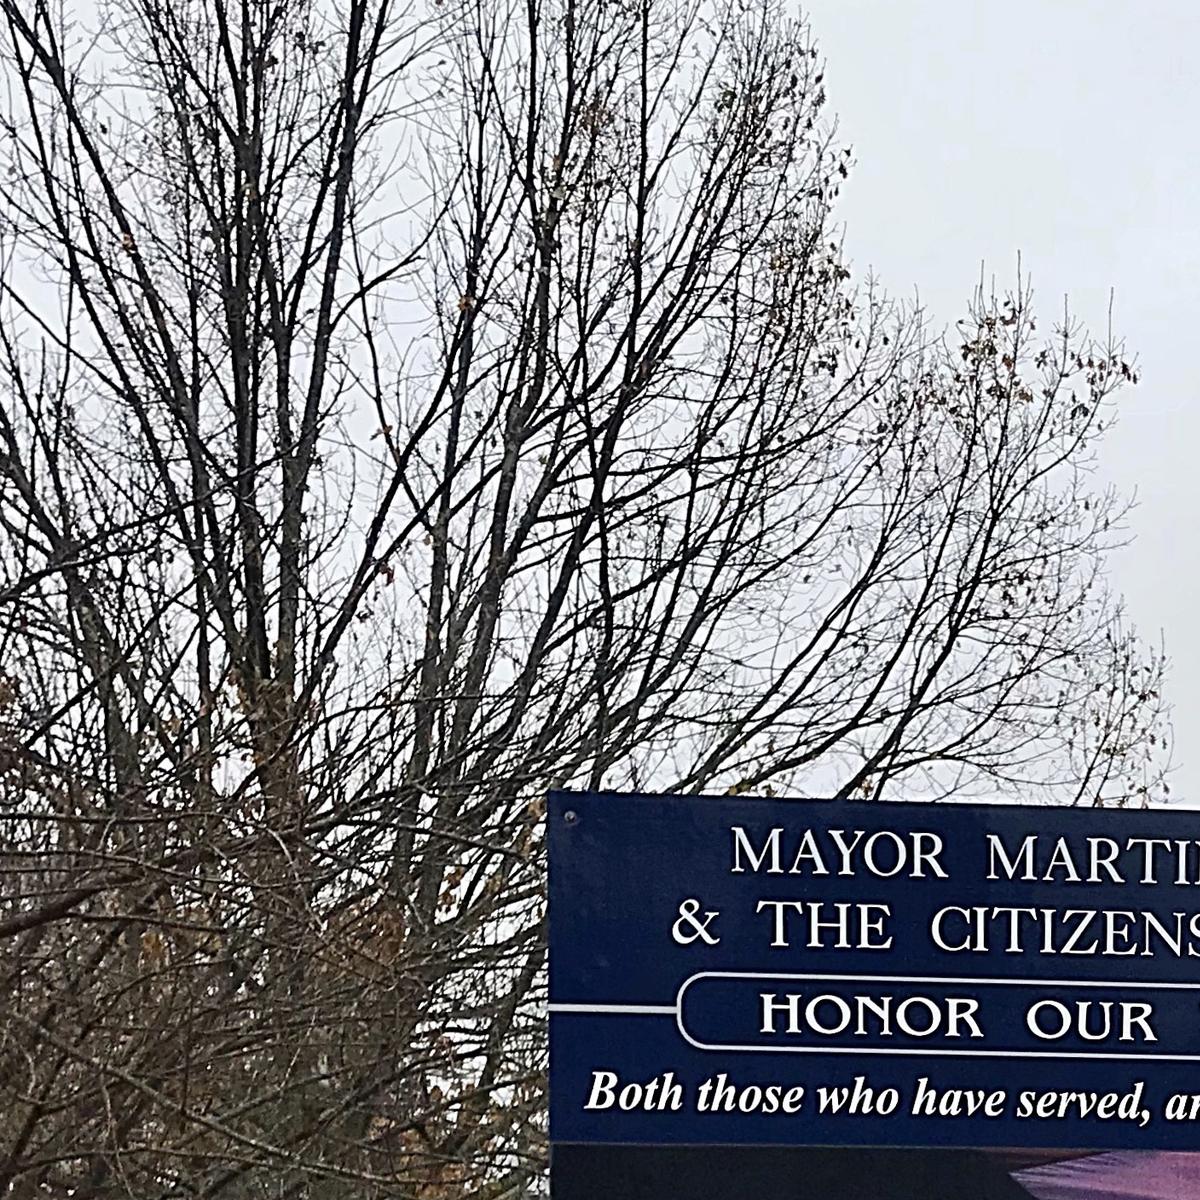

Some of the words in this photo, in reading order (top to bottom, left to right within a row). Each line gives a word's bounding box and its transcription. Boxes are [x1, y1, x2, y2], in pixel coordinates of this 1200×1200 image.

[730, 826, 949, 878] MAYOR
[672, 898, 721, 945] &
[755, 900, 893, 949] THE
[759, 993, 985, 1038] HONOR
[1026, 999, 1158, 1041] OUR
[583, 1071, 683, 1111] Both
[697, 1073, 805, 1114] those
[816, 1076, 899, 1115] who
[911, 1077, 1006, 1117] have
[1016, 1081, 1150, 1127] served,
